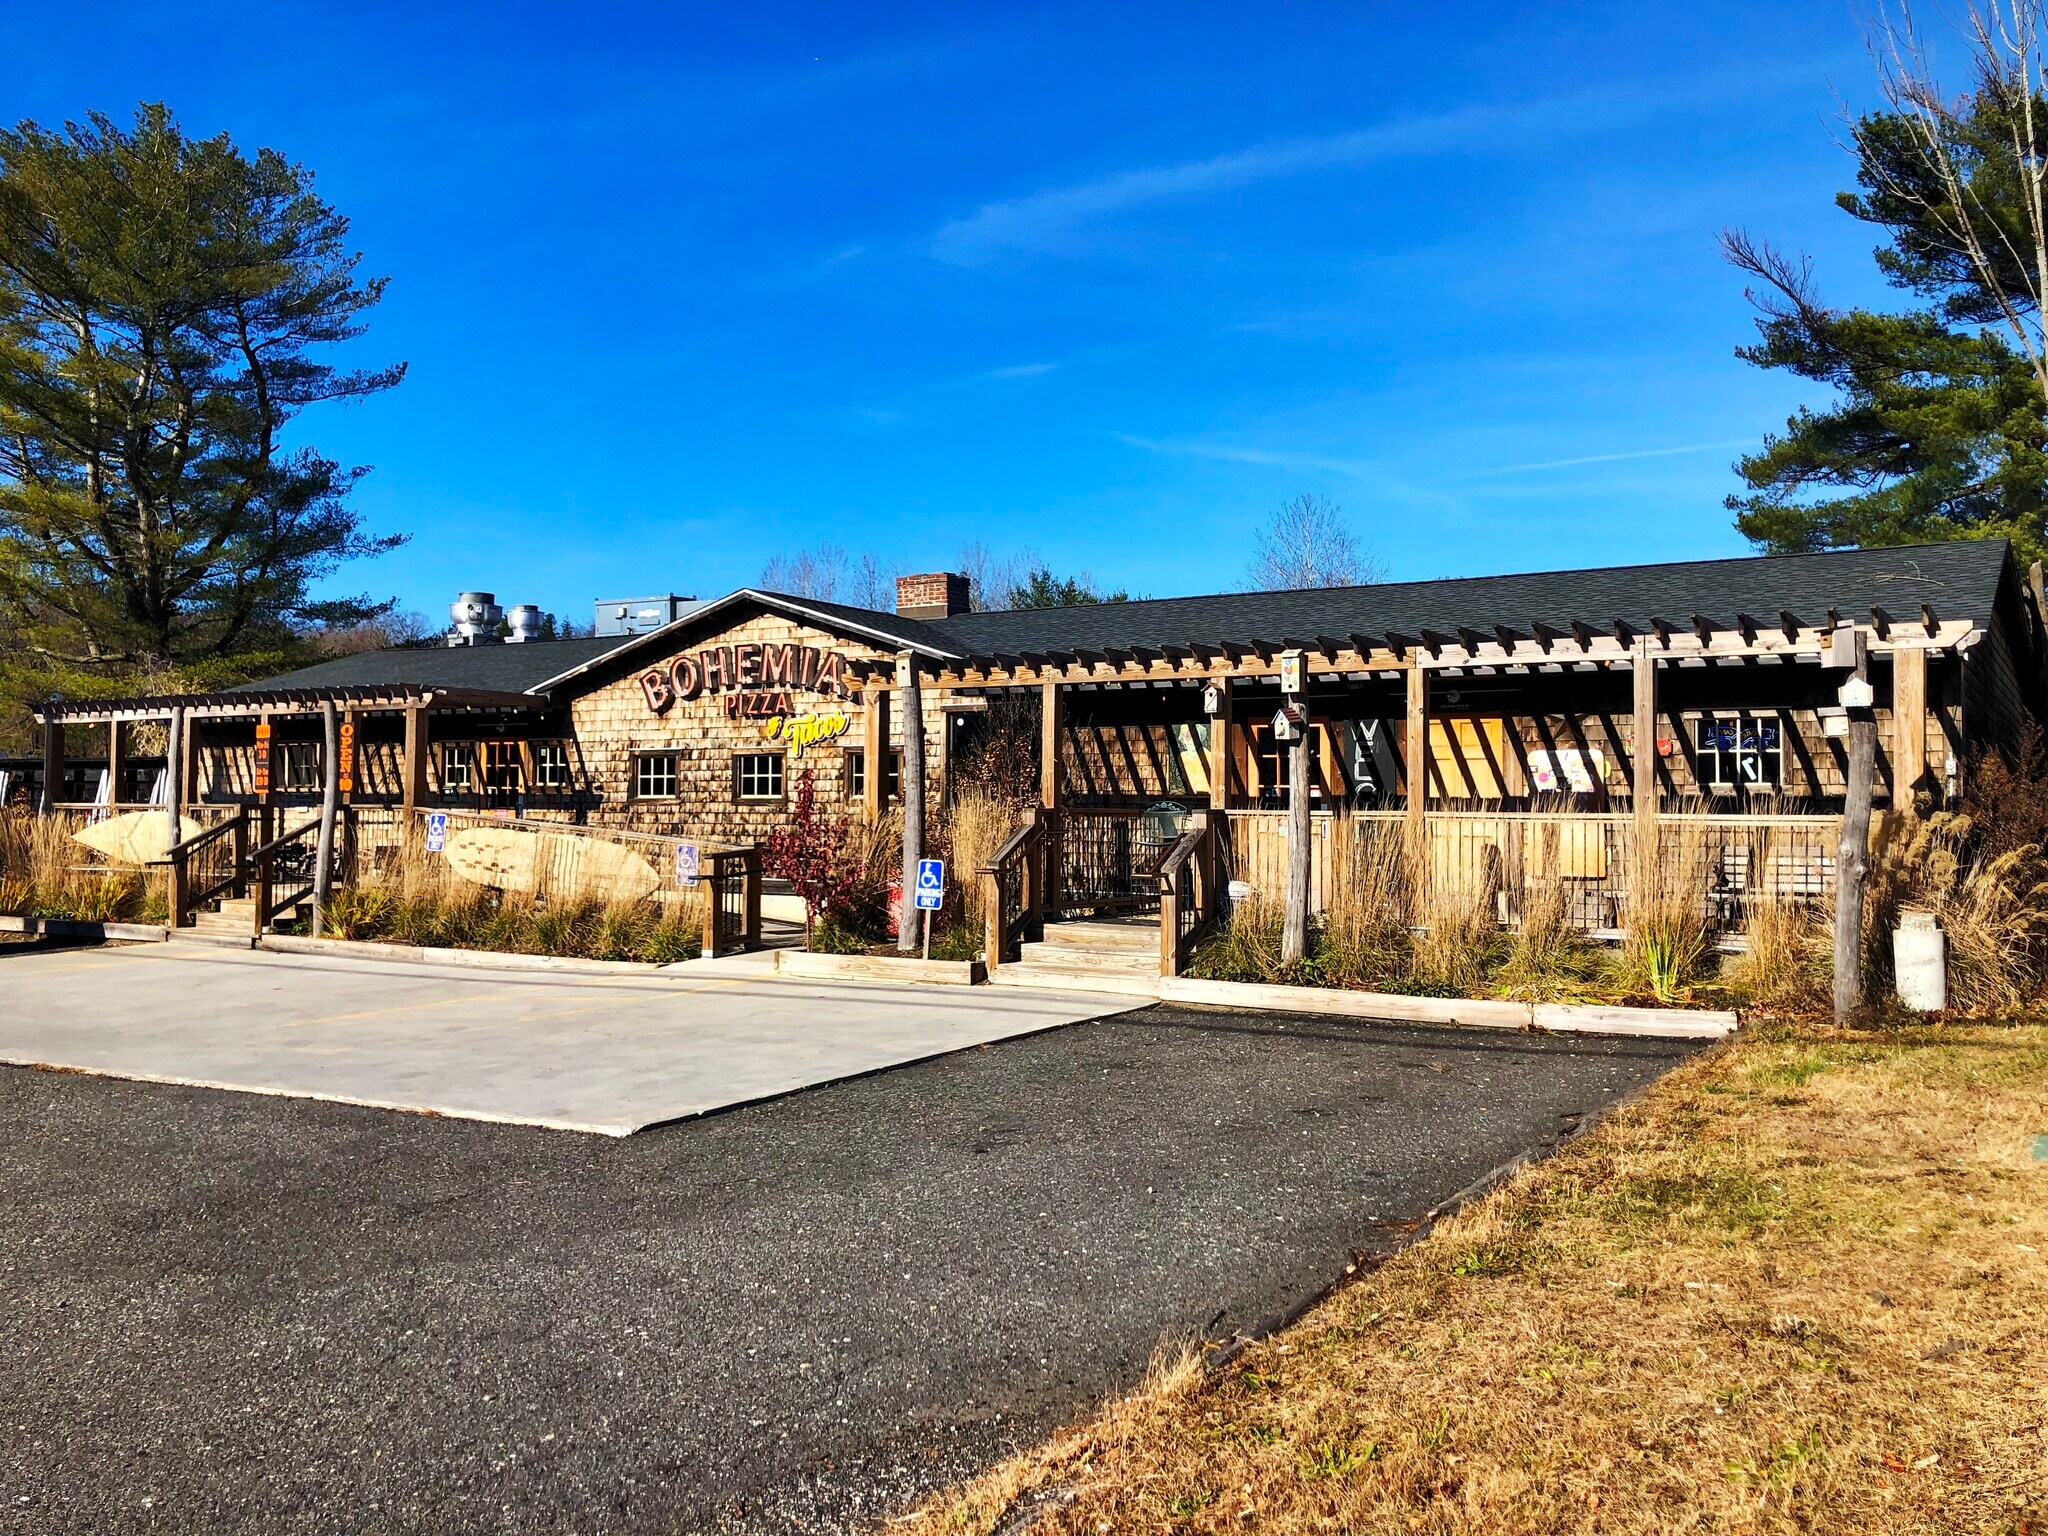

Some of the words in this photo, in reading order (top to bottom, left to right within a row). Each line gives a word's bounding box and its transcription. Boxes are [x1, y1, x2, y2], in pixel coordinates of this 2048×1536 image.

[640, 643, 845, 713] BOHEMIA
[723, 693, 791, 715] PIZZA
[340, 724, 354, 772] OPEN
[781, 708, 850, 758] Tacos
[920, 897, 937, 906] ONLY
